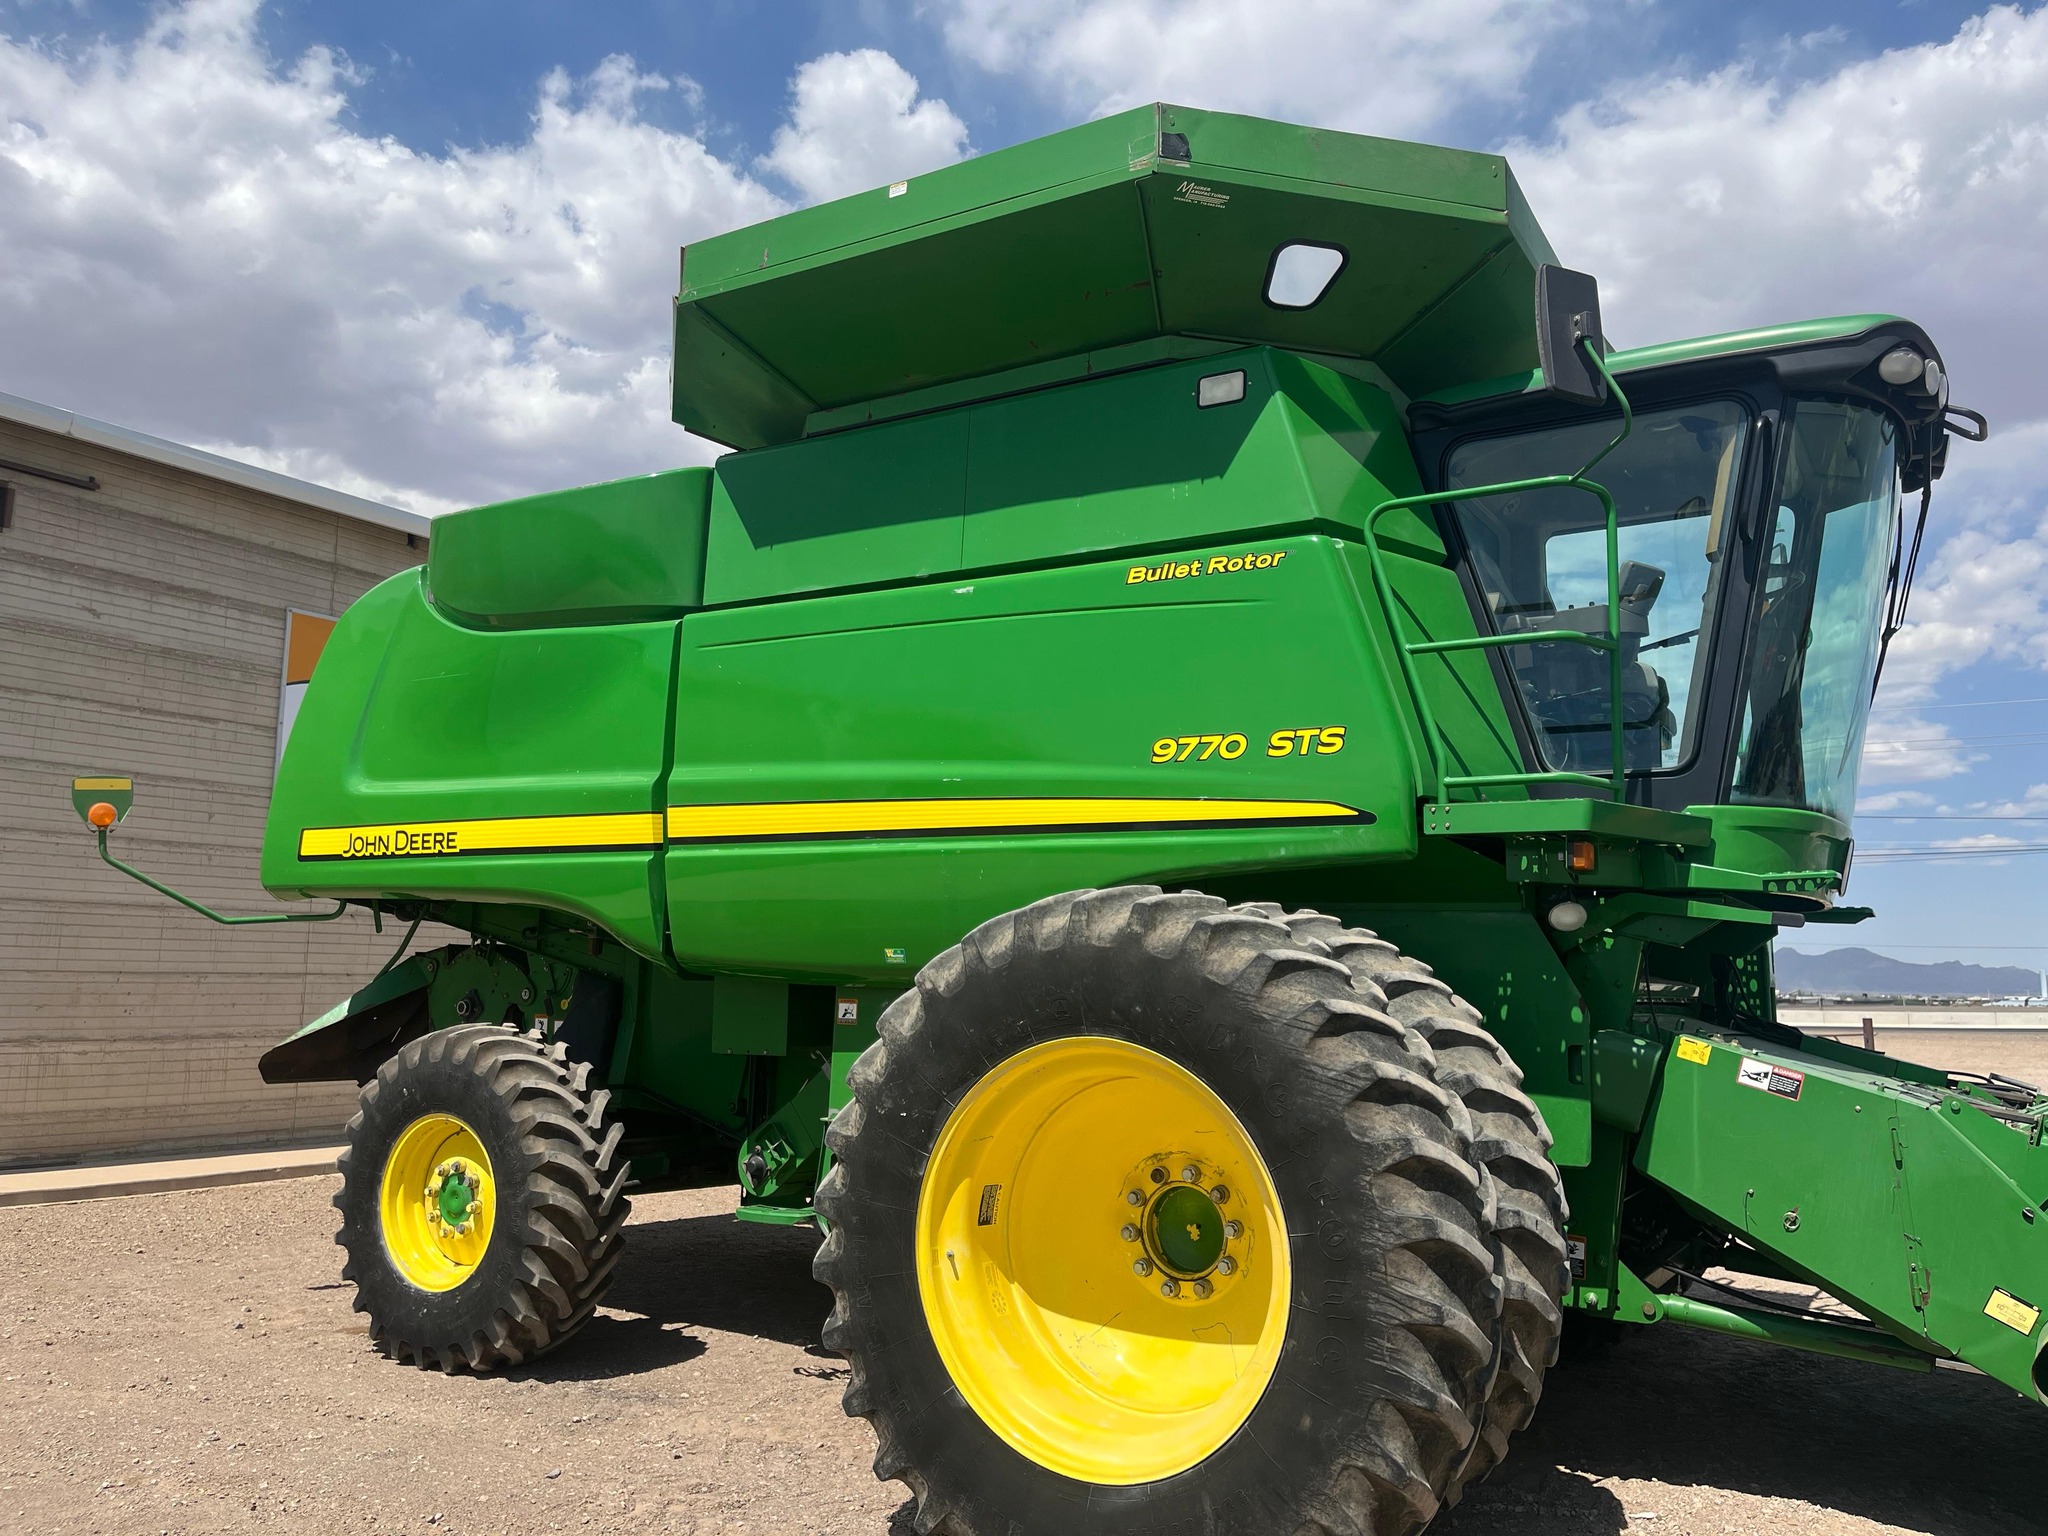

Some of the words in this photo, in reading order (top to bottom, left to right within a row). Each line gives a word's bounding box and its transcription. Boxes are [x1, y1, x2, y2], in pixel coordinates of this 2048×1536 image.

[1126, 560, 1203, 585] Bullet
[1206, 551, 1287, 576] Rotor
[1151, 732, 1249, 764] 9770
[1266, 726, 1347, 758] STS
[342, 832, 390, 855] JOHN
[394, 830, 458, 852] DEERE
